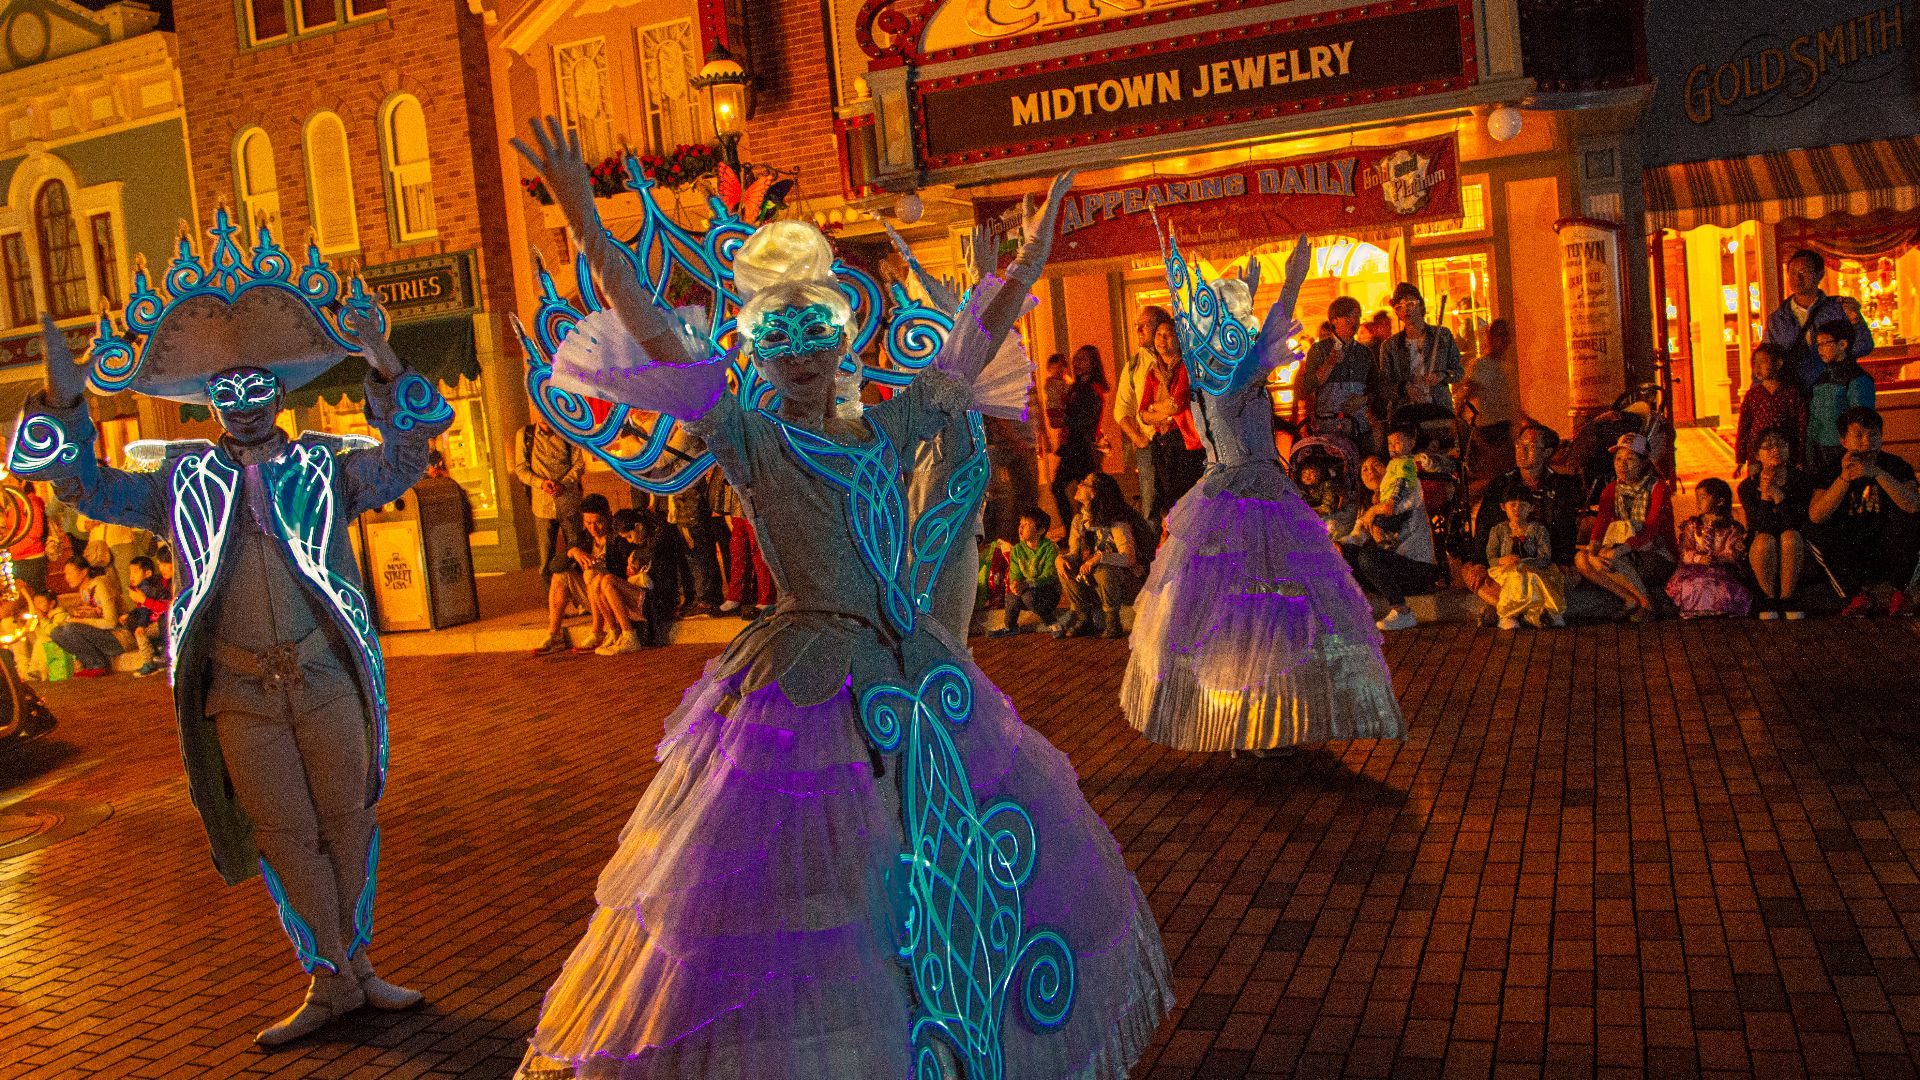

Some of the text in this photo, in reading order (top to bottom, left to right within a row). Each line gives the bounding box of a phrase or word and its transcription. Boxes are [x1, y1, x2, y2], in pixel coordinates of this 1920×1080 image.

[1011, 41, 1354, 127] MIDTOWN JEWELRY
[1061, 173, 1247, 235] APPEARING
[1257, 158, 1359, 197] DAILY
[368, 276, 442, 304] STRIES
[384, 569, 412, 587] STREET
